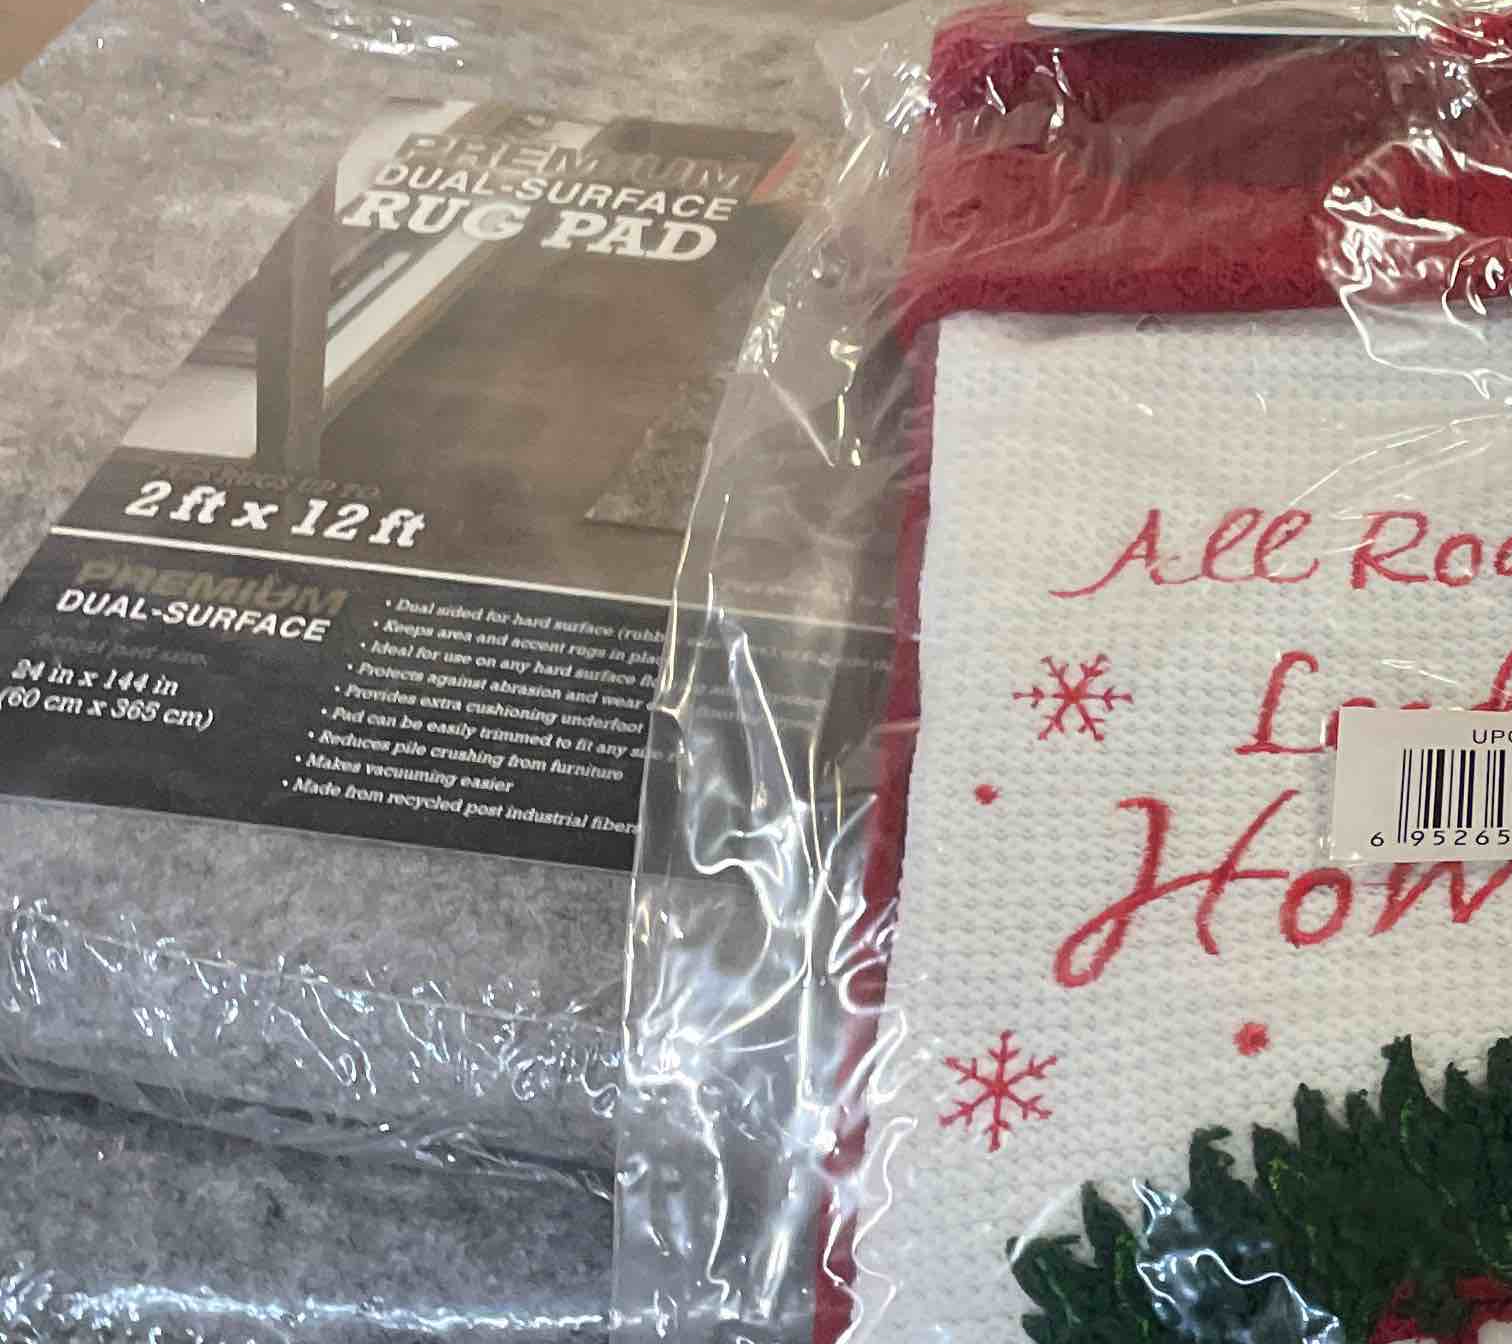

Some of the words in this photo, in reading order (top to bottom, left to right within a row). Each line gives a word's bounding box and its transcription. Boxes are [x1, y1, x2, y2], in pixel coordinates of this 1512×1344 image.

[396, 133, 761, 193] PREMUM
[375, 163, 738, 223] DUAL-SURFACE
[341, 189, 531, 241] RUG
[540, 208, 718, 263] PAD
[230, 500, 279, 531] x
[1048, 507, 1321, 599] All
[76, 558, 349, 616] PREMIUM
[56, 587, 332, 643] DUAL-SURFACE
[383, 618, 435, 639] Keeps
[437, 628, 473, 643] area
[476, 632, 509, 647] and
[511, 636, 565, 654] accent
[568, 644, 607, 660] rugs
[608, 647, 627, 662] in
[396, 597, 436, 616] Dual
[486, 608, 511, 624] for
[512, 612, 551, 630] hard
[553, 619, 614, 638] surface
[48, 663, 76, 687] in
[77, 670, 99, 689] x
[101, 668, 147, 696] 144
[153, 674, 181, 698] in
[357, 661, 425, 683] Protects
[426, 671, 488, 690] against
[489, 678, 563, 701] abrasion
[564, 688, 600, 705] and
[601, 695, 644, 710] wear
[370, 639, 415, 657] Ideal
[415, 646, 441, 662] for
[443, 652, 473, 665] use
[475, 655, 498, 669] on
[499, 660, 532, 675] any
[532, 660, 573, 679] hard
[574, 668, 637, 687] surface
[43, 694, 84, 715] cm
[87, 700, 107, 719] x
[110, 697, 160, 724] 365
[162, 704, 215, 732] cm)
[331, 706, 366, 724] Pad
[367, 715, 397, 728] can
[399, 714, 424, 731] be
[426, 721, 478, 740] easily
[478, 723, 554, 748] trimmed
[555, 733, 573, 751] to
[575, 737, 595, 754] fit
[596, 742, 629, 759] any
[344, 683, 418, 706] Provides
[419, 695, 462, 712] extra
[466, 700, 559, 726] cushioning
[561, 710, 645, 734] underfoot
[305, 752, 362, 775] Makes
[364, 762, 459, 789] vacuuming
[460, 774, 515, 794] easier
[317, 729, 392, 753] Reduces
[391, 740, 428, 757] pile
[429, 744, 506, 769] crushing
[508, 754, 548, 772] from
[549, 759, 625, 782] furniture
[292, 776, 343, 798] Made
[343, 783, 385, 804] from
[386, 790, 464, 814] recycled
[463, 800, 505, 819] post
[505, 807, 589, 830] industrial
